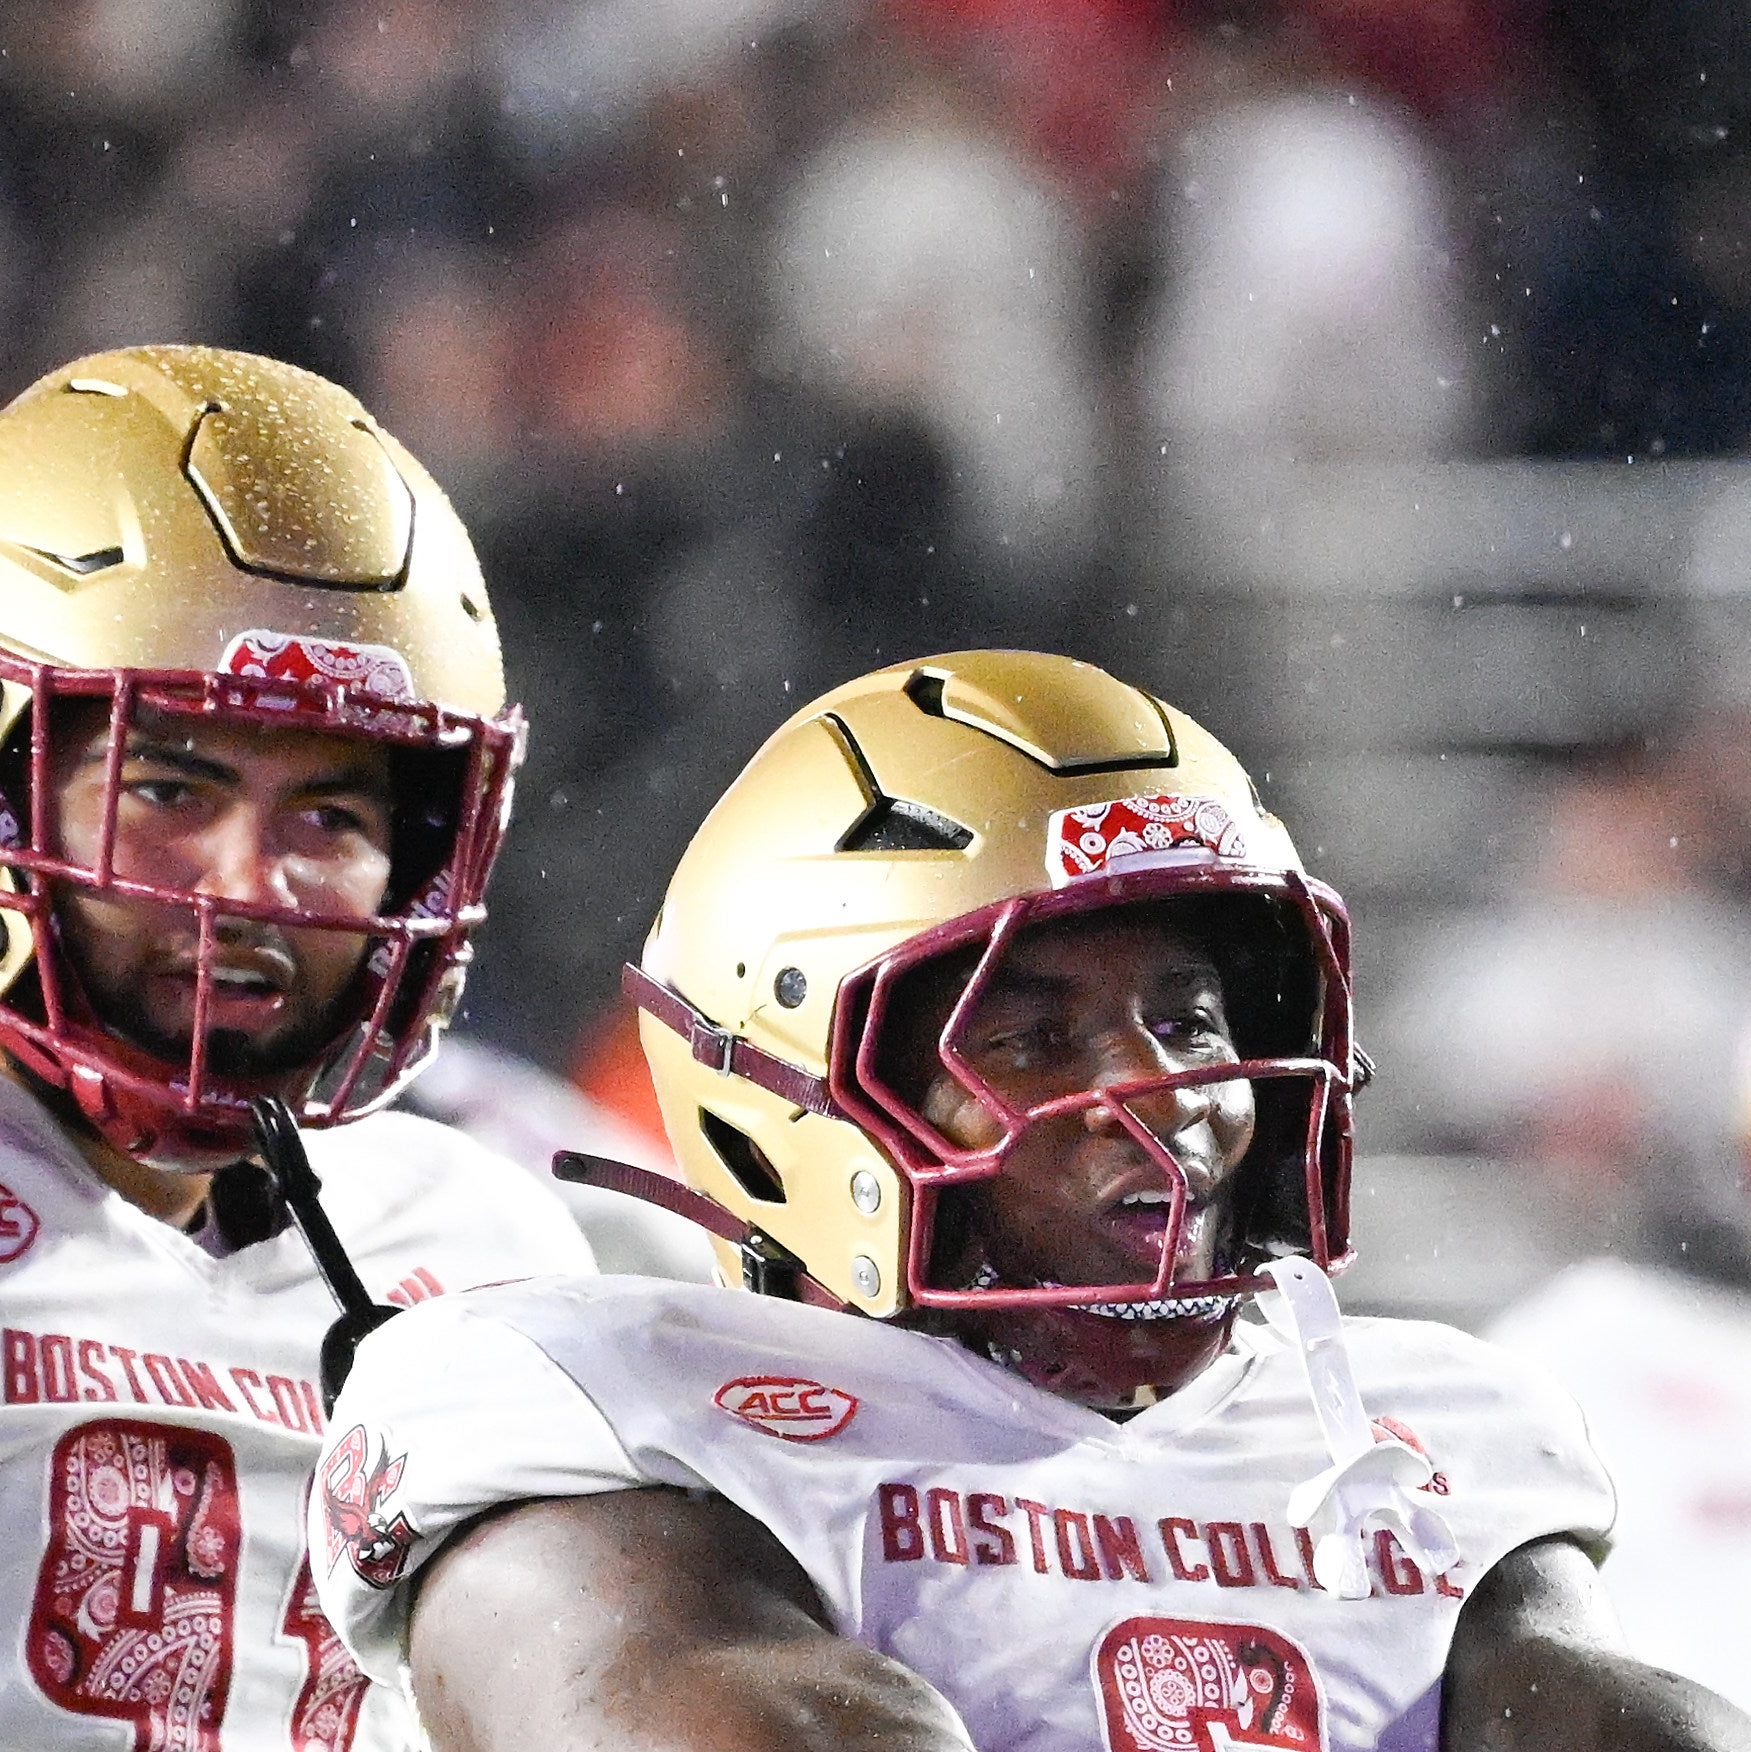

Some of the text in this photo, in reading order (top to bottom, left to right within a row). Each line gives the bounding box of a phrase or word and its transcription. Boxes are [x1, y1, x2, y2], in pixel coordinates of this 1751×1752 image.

[3, 1328, 326, 1437] BOSTON COL
[738, 1387, 831, 1414] ACC
[878, 1483, 1465, 1599] BOSTON COLLG
